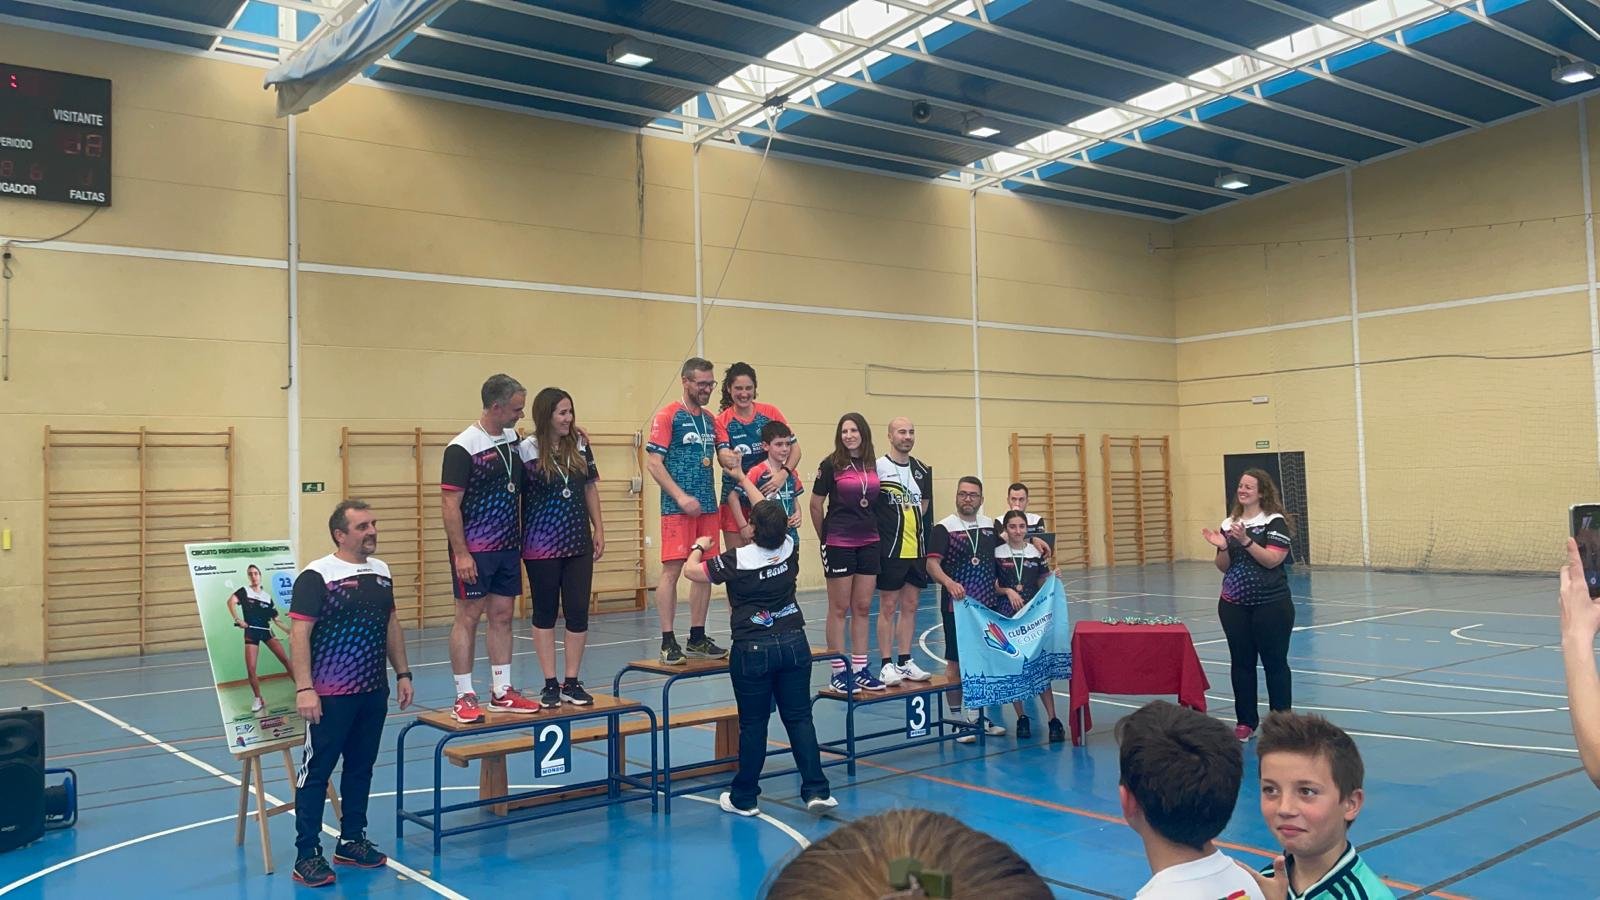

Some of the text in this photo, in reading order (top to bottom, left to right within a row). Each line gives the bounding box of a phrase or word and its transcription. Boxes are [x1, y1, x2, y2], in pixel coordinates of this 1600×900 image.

[53, 109, 103, 126] VISITANTE
[69, 189, 105, 202] FALTAS
[279, 578, 292, 588] 23
[910, 696, 926, 730] 3
[540, 724, 564, 768] 2
